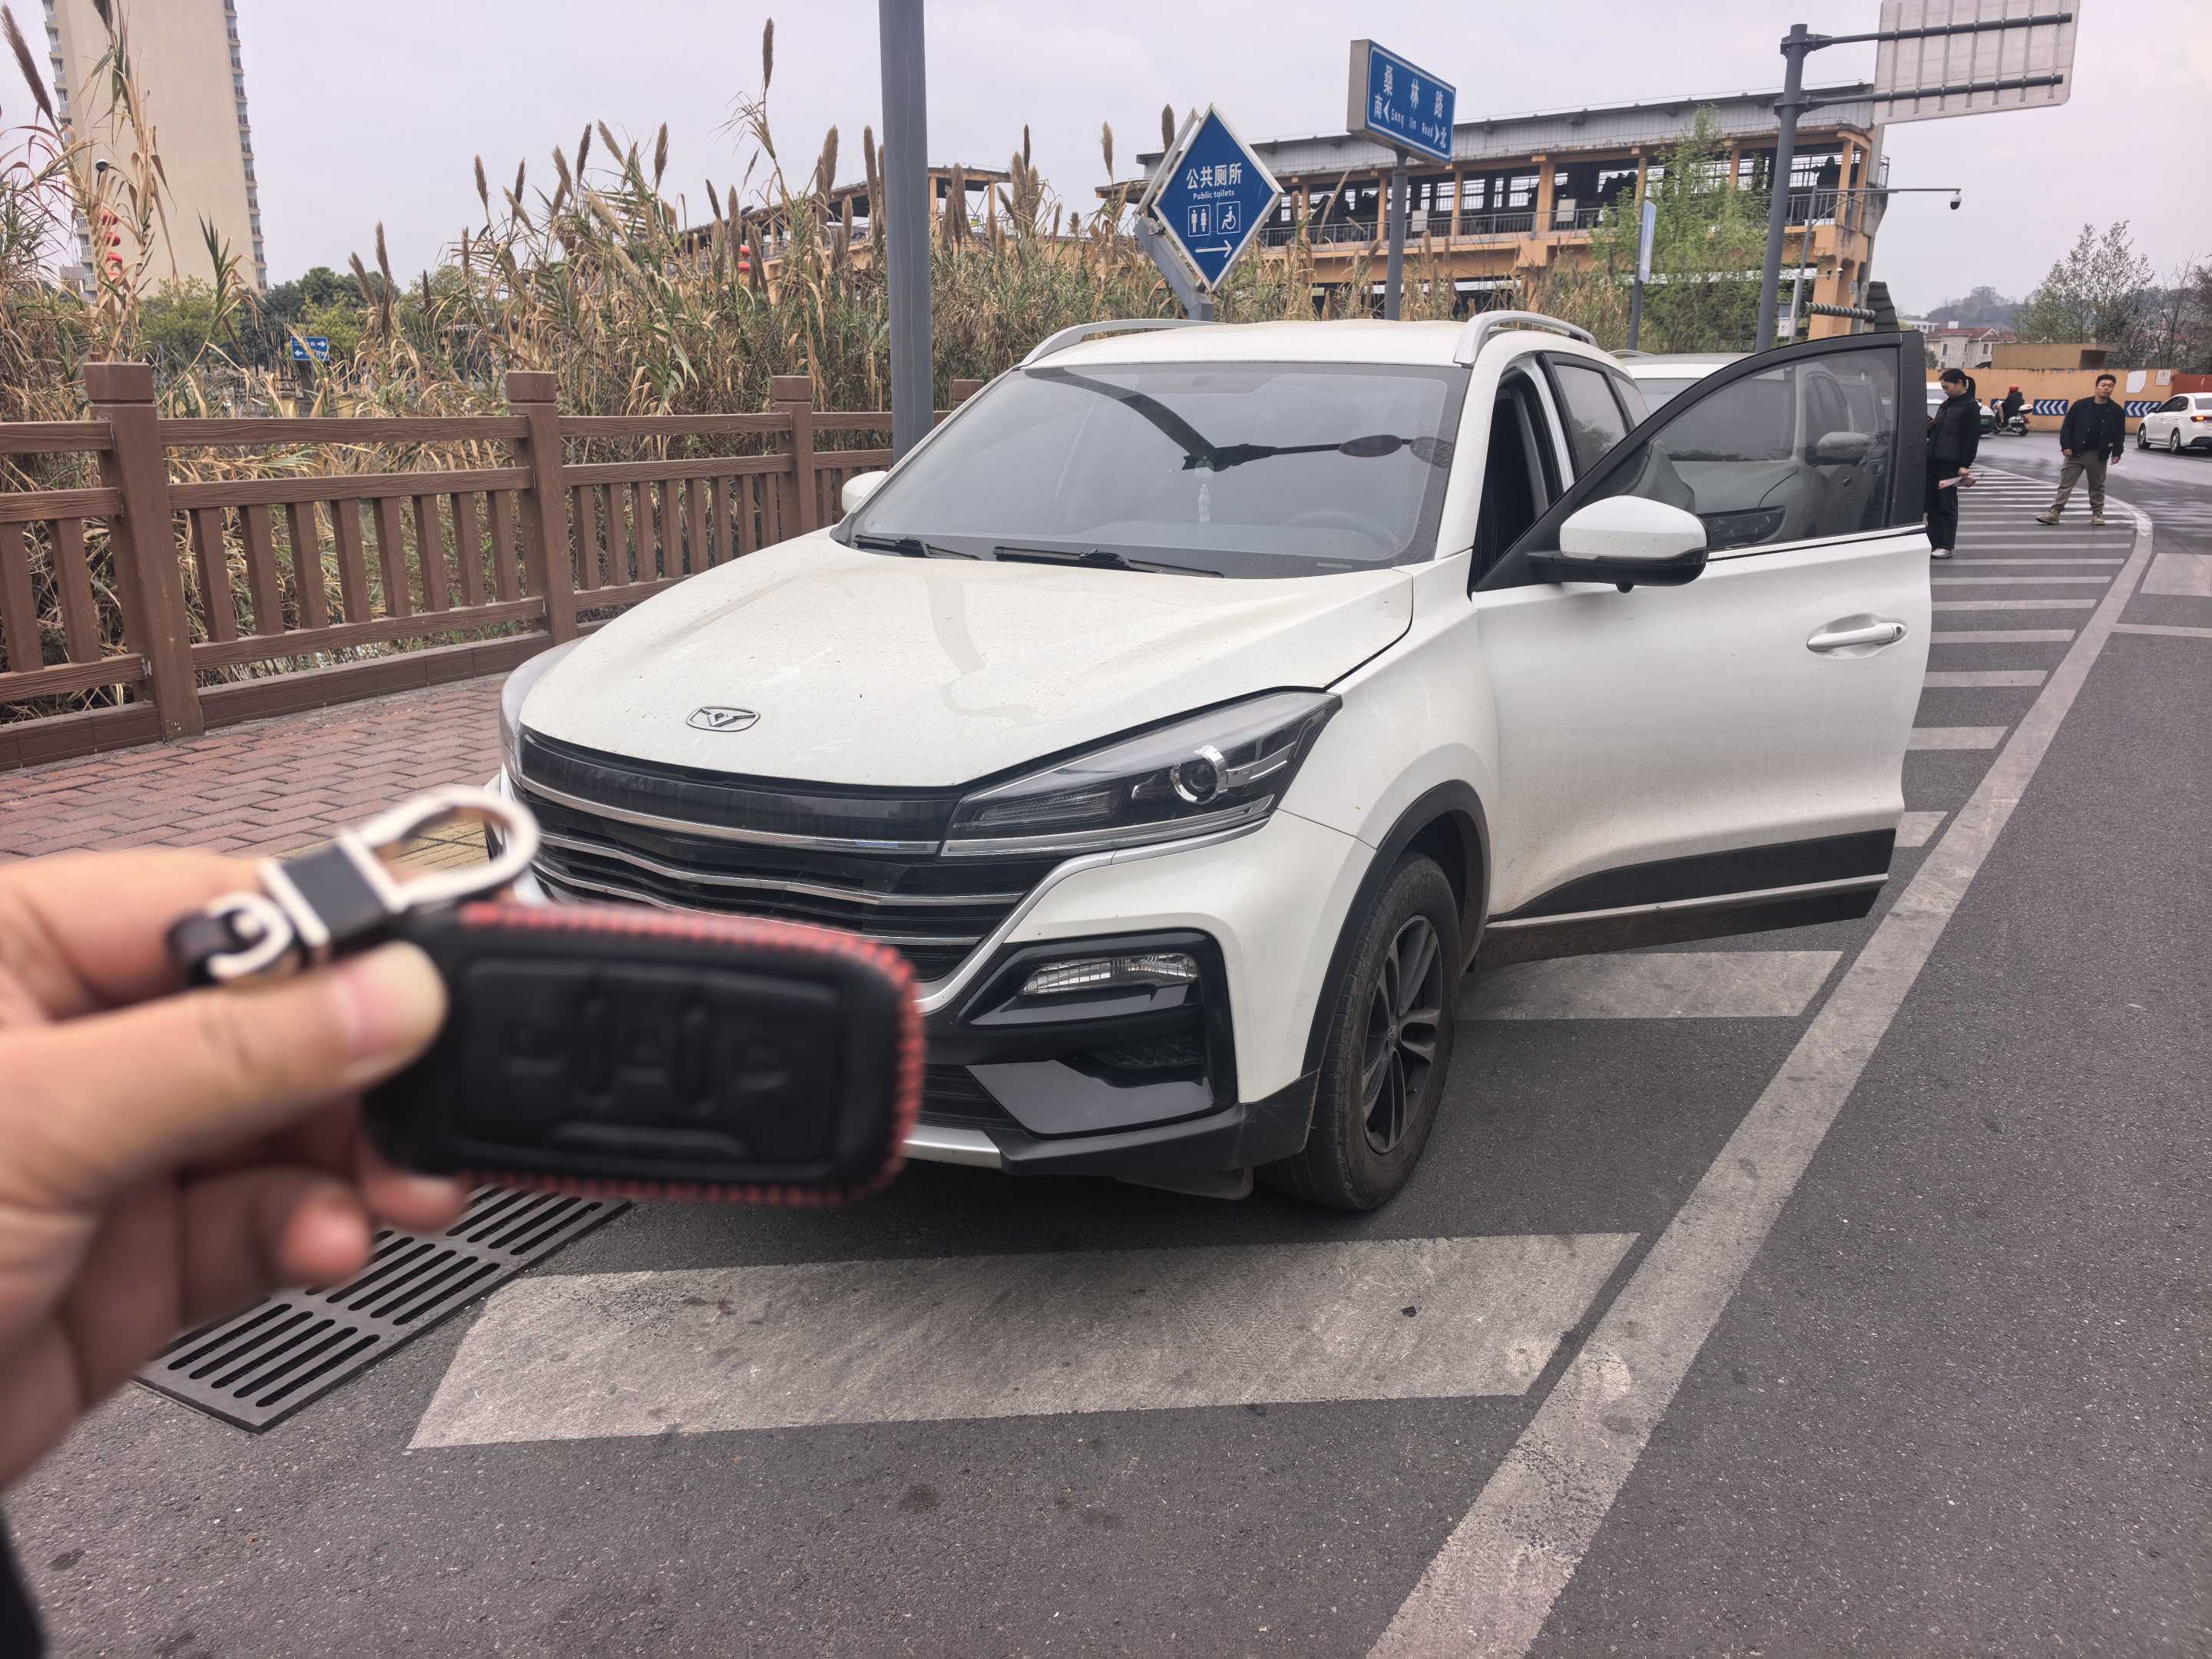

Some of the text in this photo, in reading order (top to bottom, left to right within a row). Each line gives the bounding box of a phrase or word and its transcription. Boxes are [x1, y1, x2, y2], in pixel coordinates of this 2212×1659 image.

[1384, 65, 1443, 118] 桑林路
[1374, 93, 1382, 119] 南
[1391, 108, 1404, 127] Sang
[1422, 122, 1433, 137] Road
[1439, 126, 1447, 148] 北
[1187, 162, 1242, 190] 公共厕所
